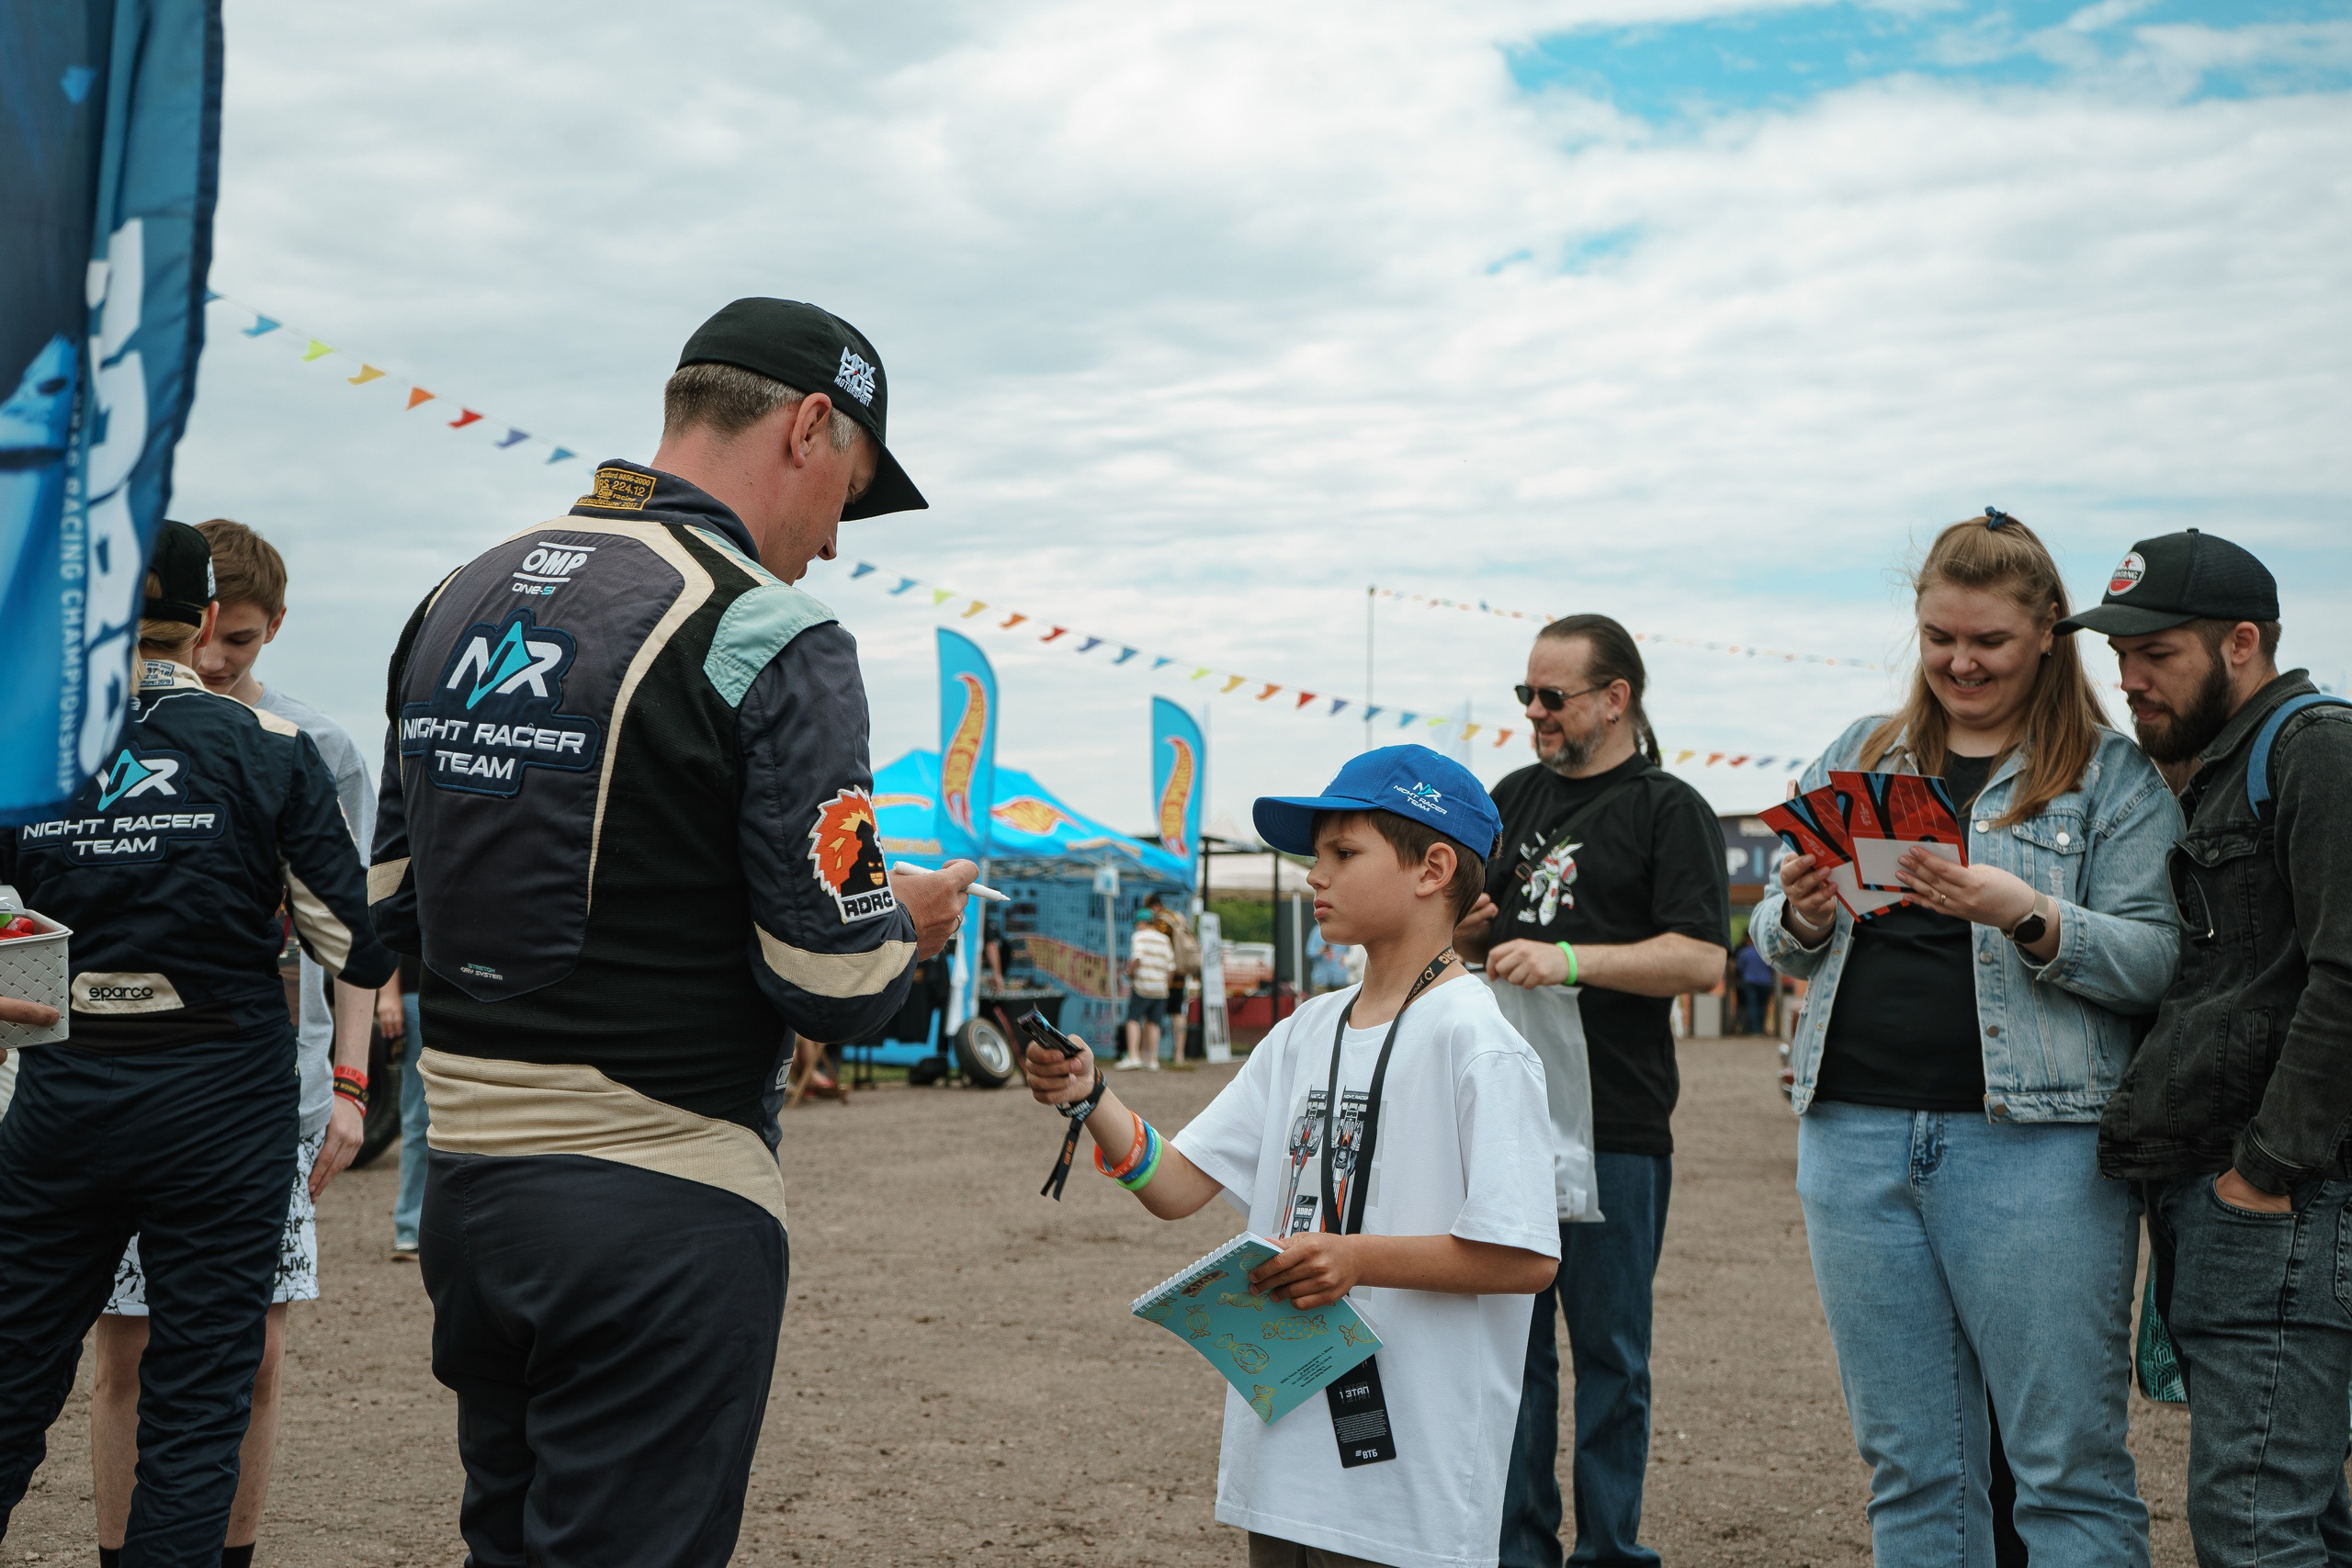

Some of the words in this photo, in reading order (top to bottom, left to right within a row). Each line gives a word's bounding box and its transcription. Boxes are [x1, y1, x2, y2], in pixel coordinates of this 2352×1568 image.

[834, 375, 872, 407] MOTORSPORT
[60, 479, 85, 581] RACING
[522, 548, 588, 576] OMP
[57, 589, 85, 796] CHAMPIONSHIP
[403, 717, 469, 741] NIGHT
[473, 723, 586, 754] RACER
[435, 750, 516, 780] TEAM
[1393, 784, 1419, 798] NIGHT
[1419, 797, 1448, 815] RACER
[1407, 795, 1430, 812] TEAM
[23, 818, 105, 840] NIGHT
[112, 813, 216, 834] RACER
[73, 836, 157, 856] TEAM
[468, 964, 496, 974] STRETCH
[475, 970, 503, 981] SYSTEM
[89, 987, 154, 1001] sparco
[1345, 1385, 1370, 1398] ЭТАП
[1362, 1449, 1378, 1460] ВТБ
